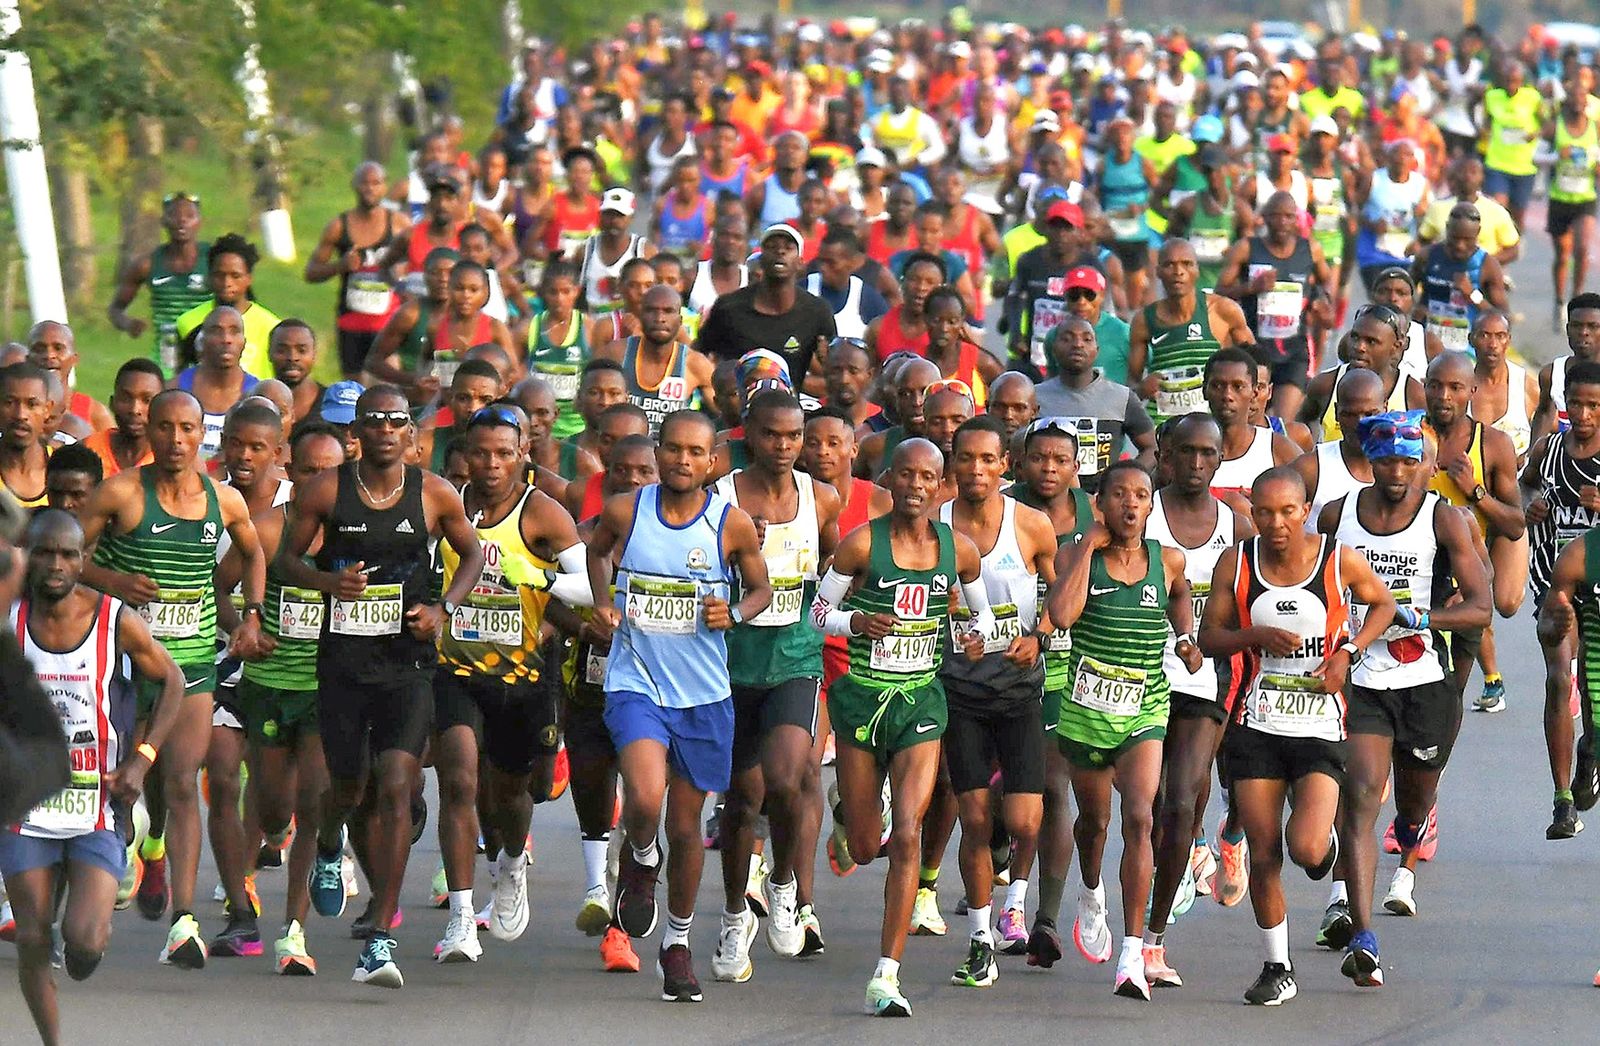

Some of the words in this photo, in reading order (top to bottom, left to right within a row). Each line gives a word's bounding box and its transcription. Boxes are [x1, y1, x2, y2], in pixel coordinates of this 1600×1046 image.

[662, 382, 683, 399] 40
[629, 595, 637, 606] A
[644, 596, 695, 620] 42038
[770, 590, 802, 613] 1998
[897, 585, 925, 615] 40
[282, 604, 292, 615] A
[333, 601, 343, 611] A
[350, 602, 401, 624] 41868
[333, 611, 346, 623] MO
[628, 607, 641, 618] MO
[1351, 605, 1358, 615] B
[282, 615, 296, 626] MO
[455, 607, 464, 618] A
[470, 609, 520, 633] 41896
[455, 619, 471, 630] M40
[954, 621, 963, 632] A
[990, 618, 1020, 642] 045
[874, 647, 892, 659] M40
[891, 636, 936, 660] 41970
[590, 656, 600, 667] A
[1077, 682, 1090, 695] MO
[1078, 672, 1088, 684] A
[1092, 678, 1142, 704] 41973
[1258, 703, 1272, 714] MO
[1259, 690, 1269, 702] A
[1275, 692, 1326, 716] 42072
